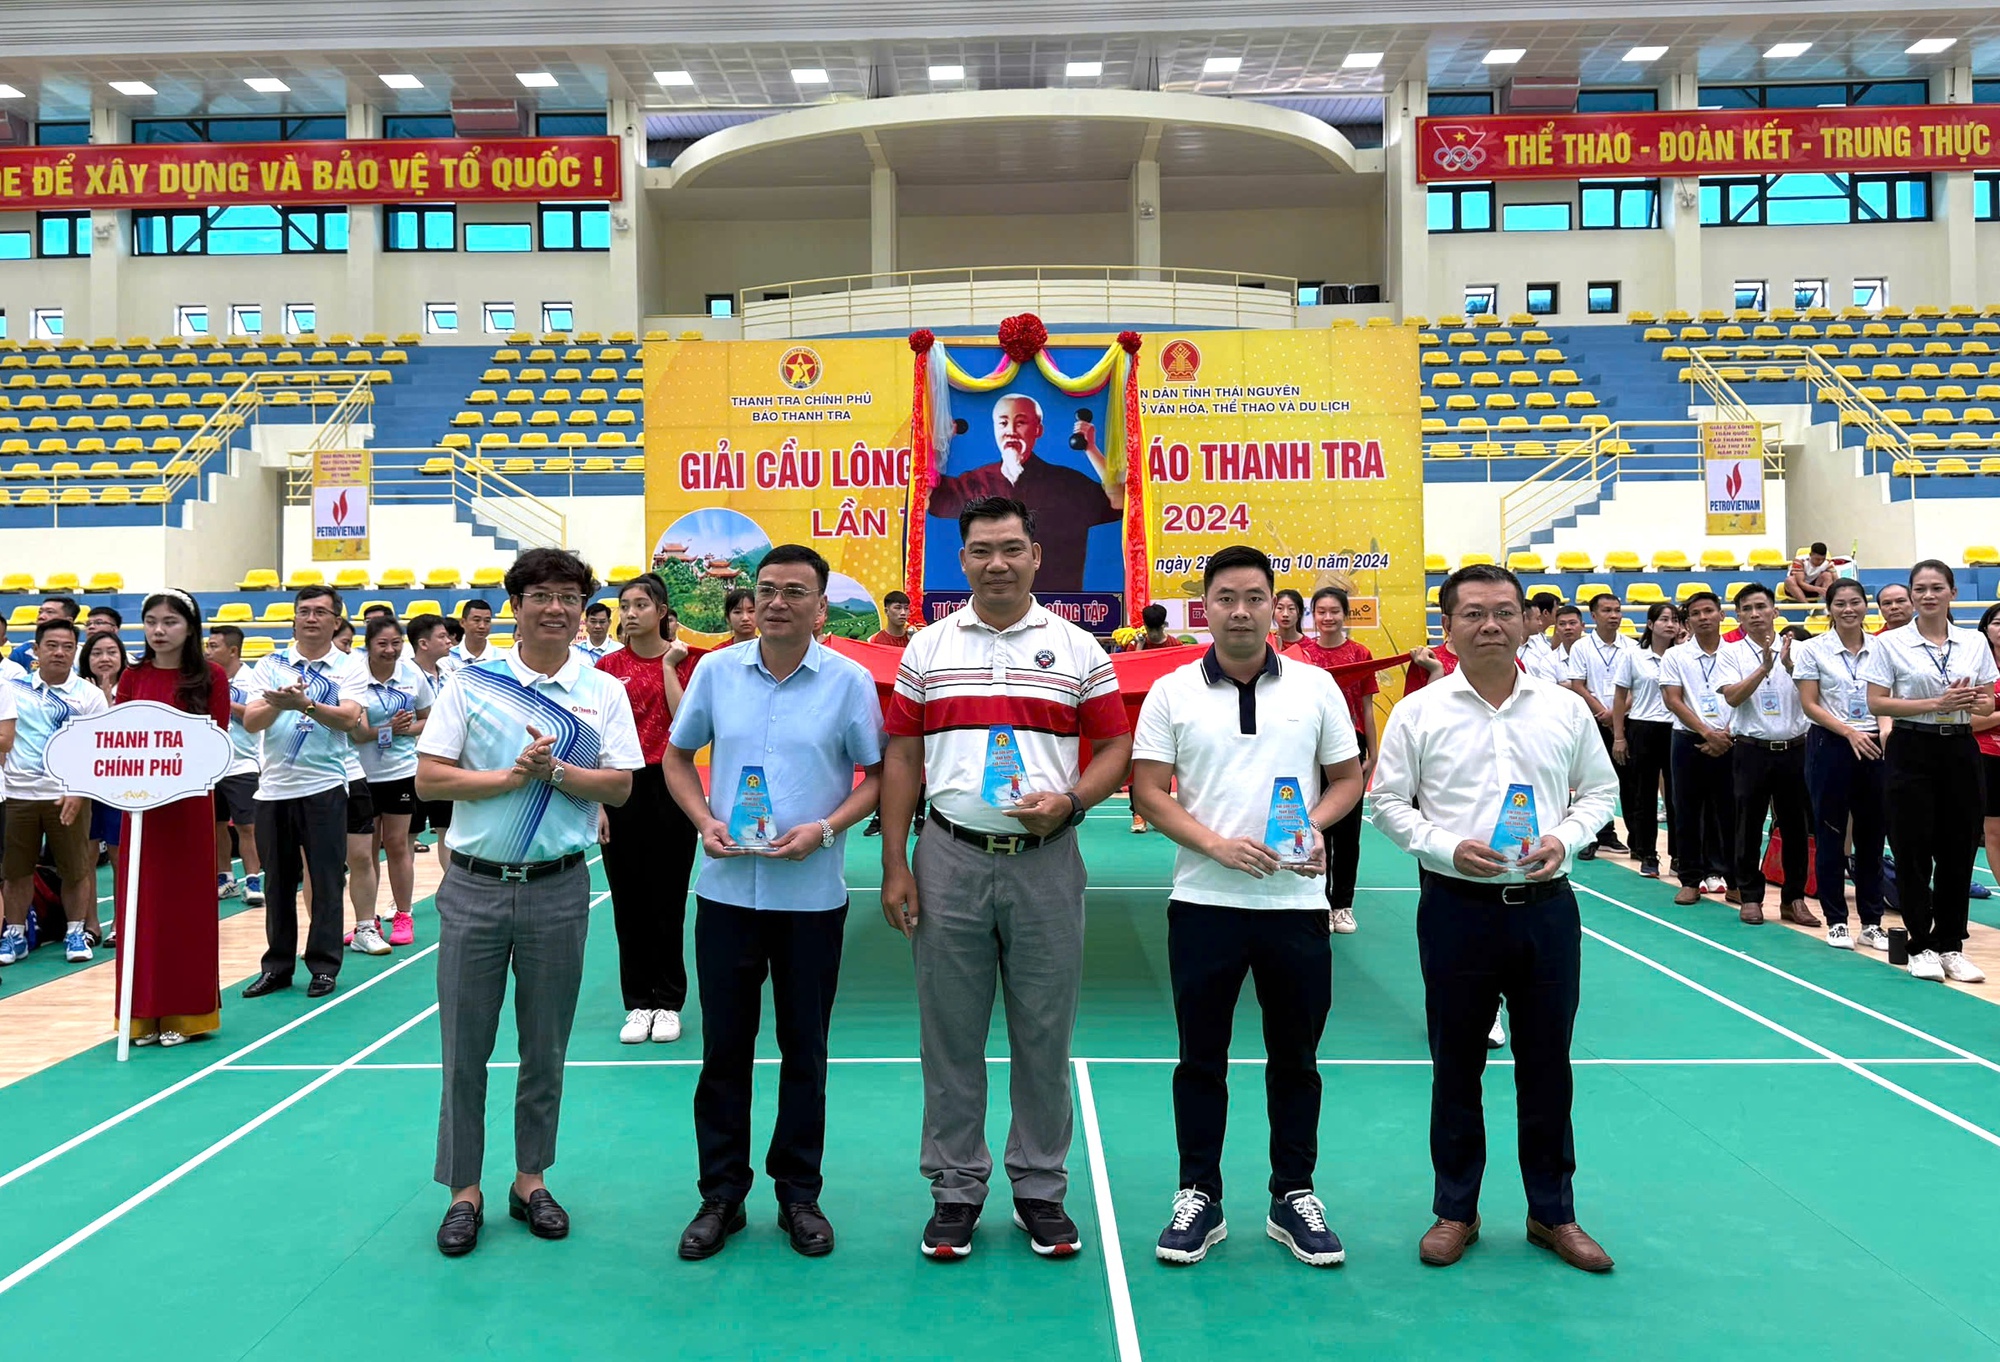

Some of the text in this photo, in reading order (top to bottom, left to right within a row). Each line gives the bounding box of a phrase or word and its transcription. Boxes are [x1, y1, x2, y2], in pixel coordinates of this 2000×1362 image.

[1504, 121, 1555, 165] THỂ
[1562, 132, 1631, 165] THAO
[1659, 124, 1734, 162] ĐOÀN
[1743, 118, 1793, 160] KẾT
[1820, 126, 1911, 158] TRUNG
[1919, 121, 1990, 163] THỰC
[0, 166, 21, 197] E
[32, 153, 75, 196] ĐỂ
[84, 158, 149, 195] XÂY
[159, 160, 249, 199] DỰNG
[260, 155, 302, 191] VÀ
[312, 150, 379, 190] BẢO
[389, 152, 429, 195] VỆ
[440, 146, 481, 189] TỔ
[492, 146, 580, 191] QUỐC
[731, 391, 871, 406] THANH TRA CHÍNH PHỦ
[1153, 386, 1178, 398] DÂN
[1182, 385, 1210, 398] TỈNH
[1215, 385, 1243, 397] THÁI
[1247, 384, 1300, 396] NGUYÊN
[752, 410, 851, 421] BÁO THANH TRA
[1150, 402, 1175, 414] VĂN
[1179, 402, 1209, 414] HÓA,
[1213, 399, 1238, 412] THỂ
[1242, 402, 1275, 412] THAO
[1279, 400, 1295, 411] VÀ
[1300, 402, 1317, 411] DU
[1321, 401, 1349, 413] LỊCH
[680, 438, 910, 489] GIẢI CẦU LÔNG
[1149, 437, 1385, 481] ÁO THANH TRA
[1710, 500, 1760, 511] PETROVIETNAM
[813, 498, 886, 537] LẦN
[1164, 504, 1249, 532] 2024
[317, 526, 365, 537] PETROVIETNAM
[1156, 555, 1191, 573] ngày
[1297, 555, 1313, 569] 10
[1317, 554, 1349, 569] năm
[1353, 553, 1388, 568] 2024
[1082, 600, 1108, 625] TẬP
[95, 731, 183, 748] THANH TRA
[94, 753, 183, 777] CHÍNH PHỦ
